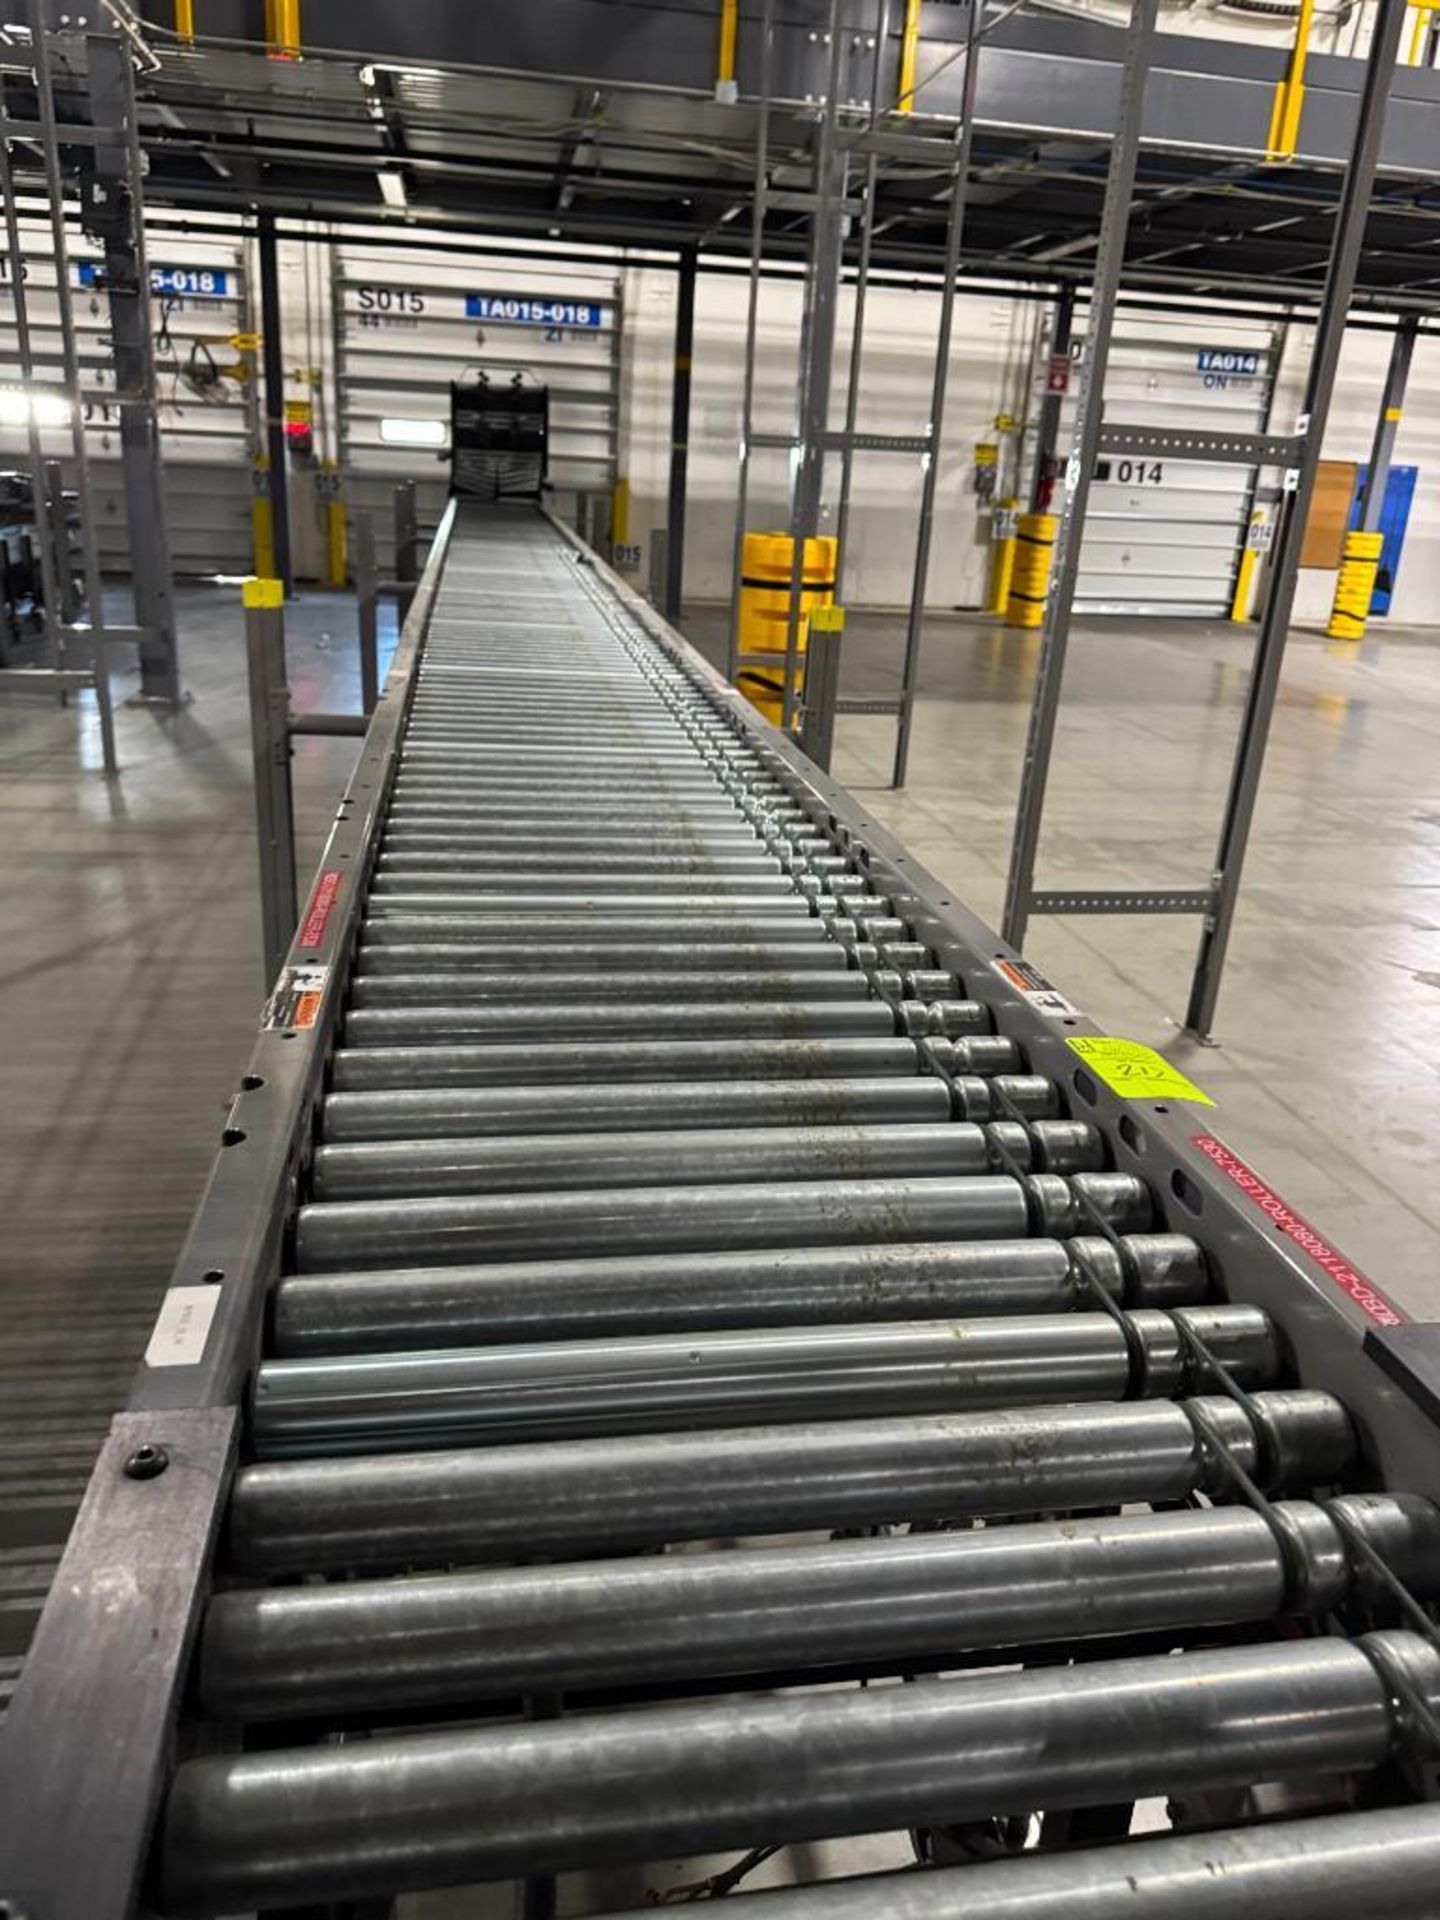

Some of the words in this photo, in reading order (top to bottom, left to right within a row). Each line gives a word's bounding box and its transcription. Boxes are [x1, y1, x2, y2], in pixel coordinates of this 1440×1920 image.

[359, 286, 424, 313] S015
[477, 297, 590, 323] TA015-018
[1202, 352, 1256, 372] TA014
[1118, 460, 1162, 484] 014
